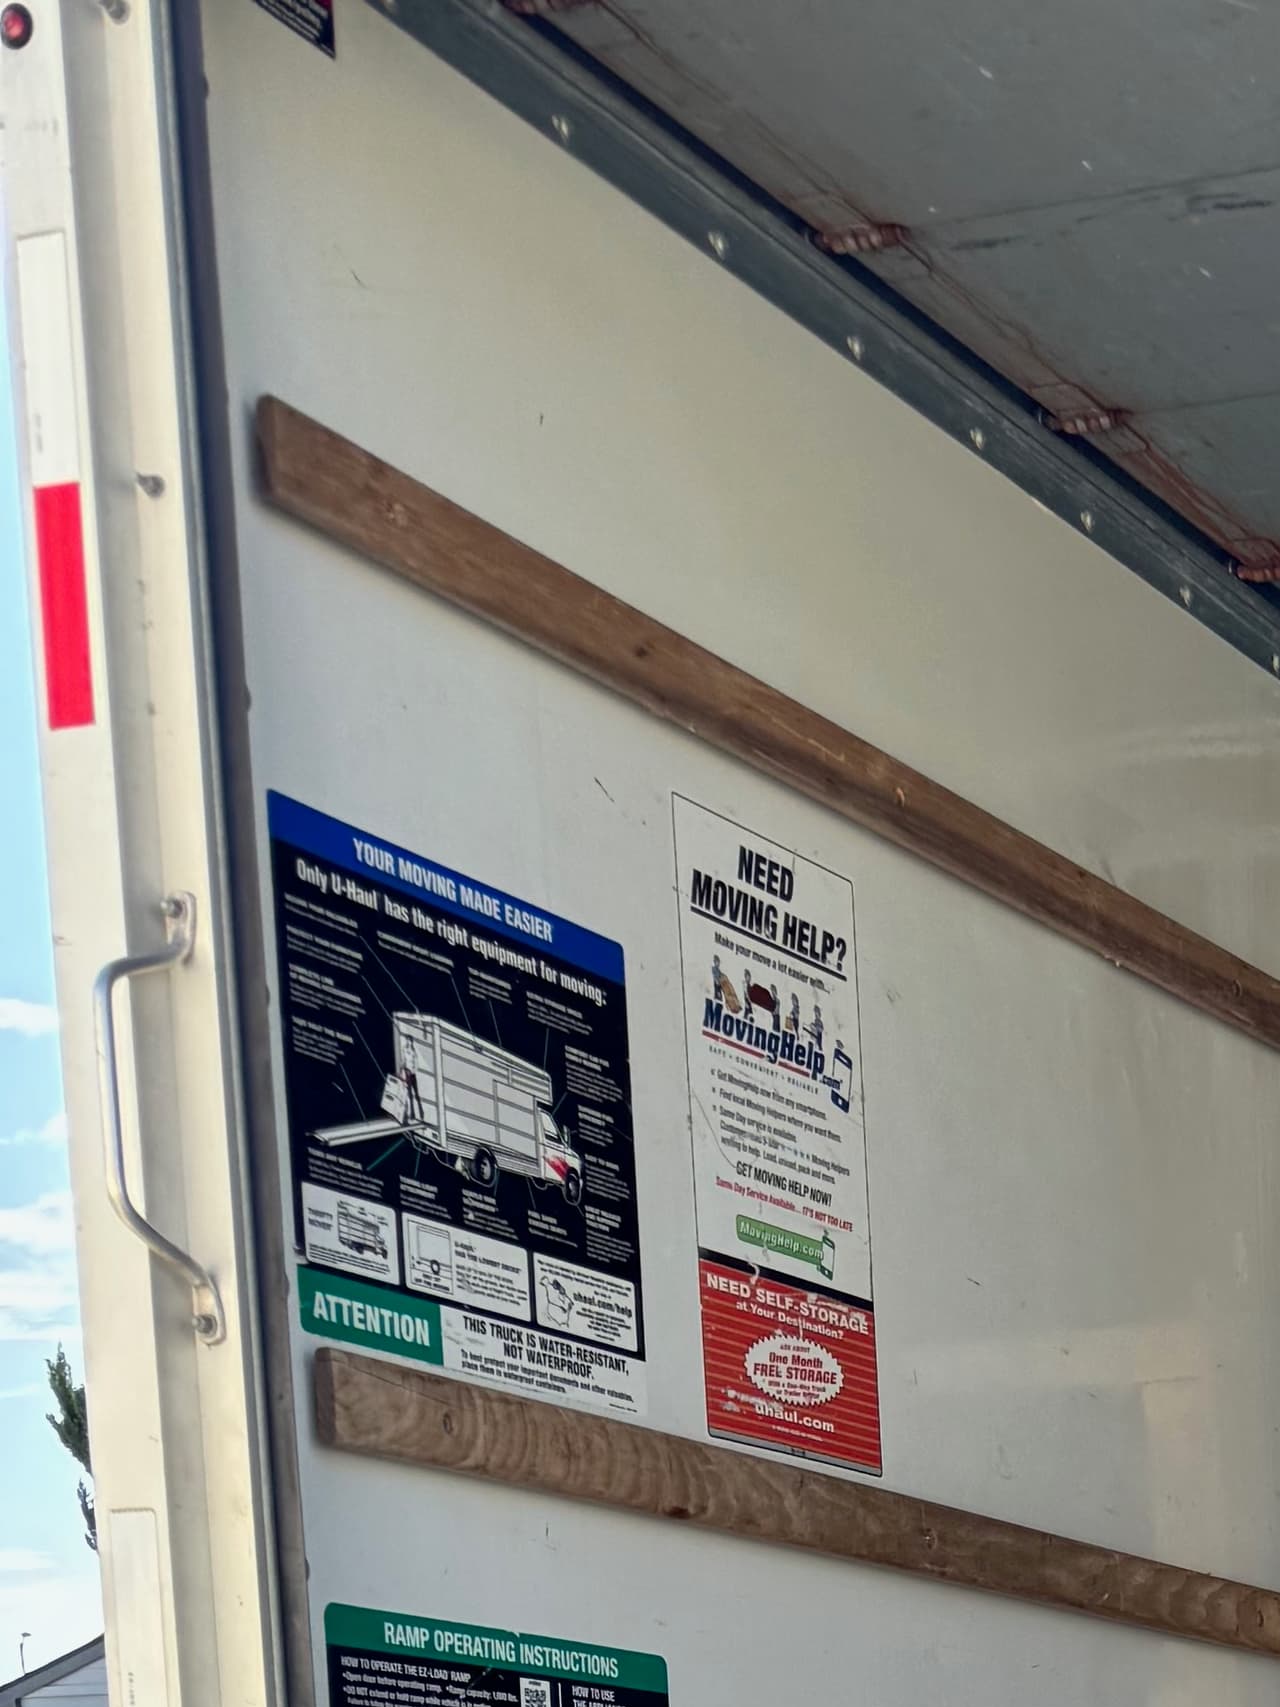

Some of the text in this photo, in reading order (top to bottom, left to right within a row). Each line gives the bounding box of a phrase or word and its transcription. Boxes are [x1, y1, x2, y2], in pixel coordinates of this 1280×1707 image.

[353, 838, 553, 943] YOUR MOVING MADE EASIER
[737, 844, 795, 903] NEED
[296, 858, 328, 894] Only
[331, 871, 379, 912] U-Haul
[384, 894, 410, 924] has
[412, 907, 434, 934] the
[437, 919, 470, 948] right
[471, 935, 538, 977] equipment
[540, 960, 557, 984] for
[560, 972, 607, 1007] moving:
[691, 868, 848, 972] MOVING HELP?
[714, 932, 735, 951] Make
[736, 1160, 832, 1207] GET MOVING HELP NOW!
[740, 1221, 824, 1261] MovingHelp.com
[312, 1291, 430, 1347] ATTENTION
[706, 1273, 869, 1335] NEED SELF-STORAGE
[736, 1301, 844, 1340] at Your Destination?
[462, 1315, 629, 1377] THIS TRUCK IS WATER-RESISTANT,
[503, 1342, 595, 1380] NOT WATERPROOF.
[768, 1351, 823, 1368] One Month
[786, 1366, 838, 1385] STORAGE
[755, 1402, 834, 1433] uhaul.com
[341, 1655, 358, 1667] HOW
[359, 1658, 370, 1668] TO
[370, 1658, 403, 1674] OPERATE
[404, 1663, 418, 1676] THE
[450, 1671, 471, 1683] RAMP
[384, 1621, 619, 1679] RAMP OPERATING INSTRUCTIONS
[572, 1685, 615, 1701] HOW TO USE
